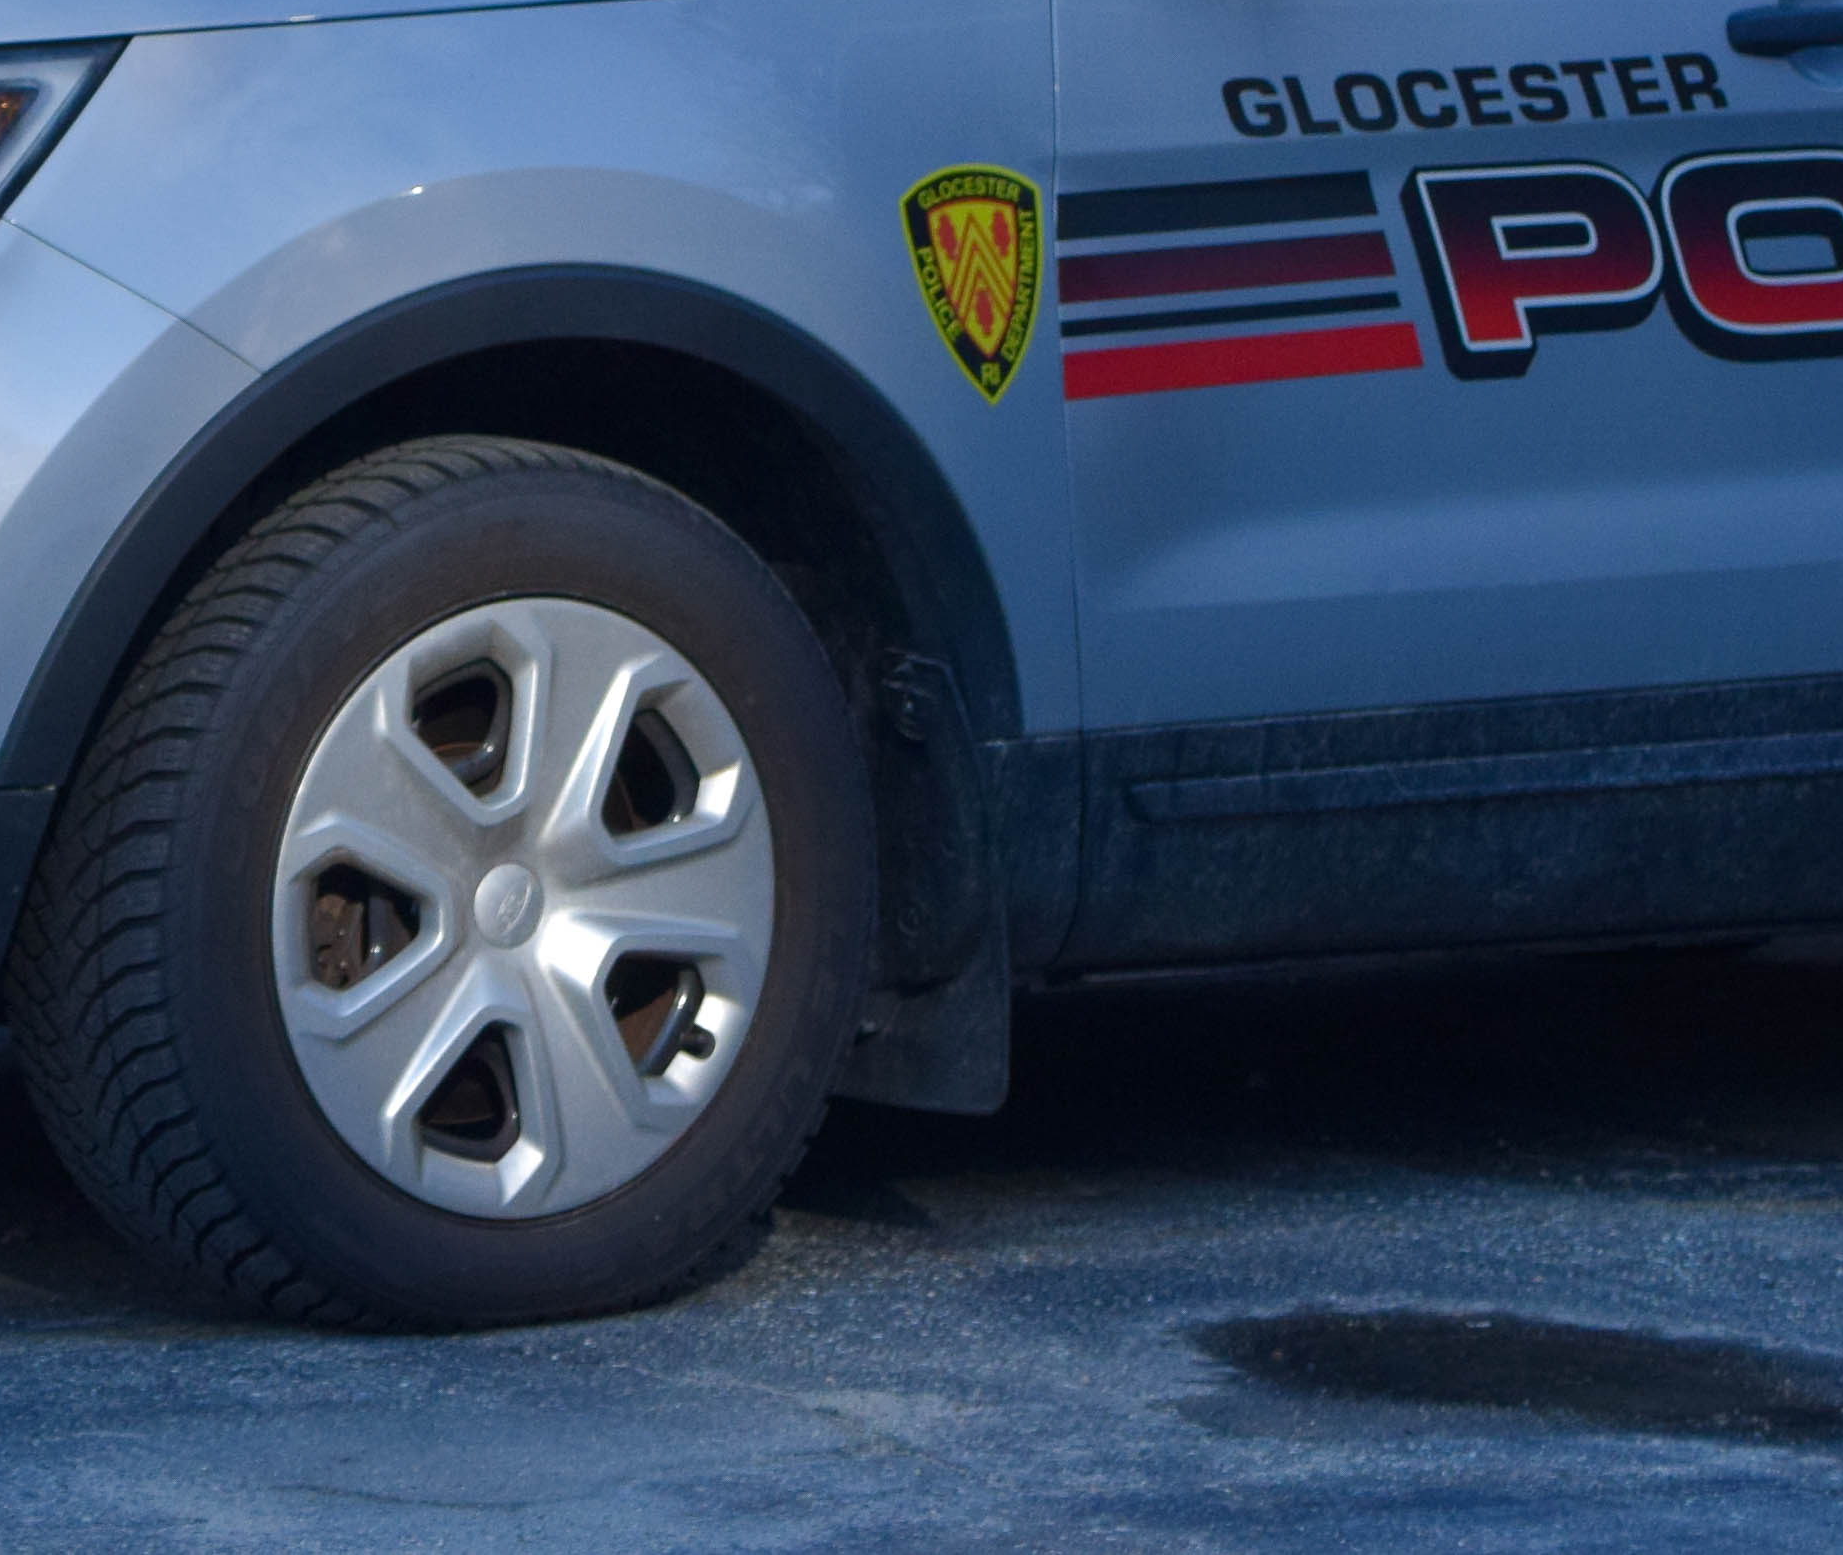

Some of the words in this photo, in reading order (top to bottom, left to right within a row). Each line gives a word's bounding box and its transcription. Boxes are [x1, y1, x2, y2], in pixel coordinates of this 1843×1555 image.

[1221, 52, 1729, 138] GLOCESTER
[917, 176, 1021, 210] GLOCESTER
[916, 246, 965, 340] POLICE
[1000, 208, 1035, 362] DEPARTMENT
[980, 361, 1001, 386] RI
